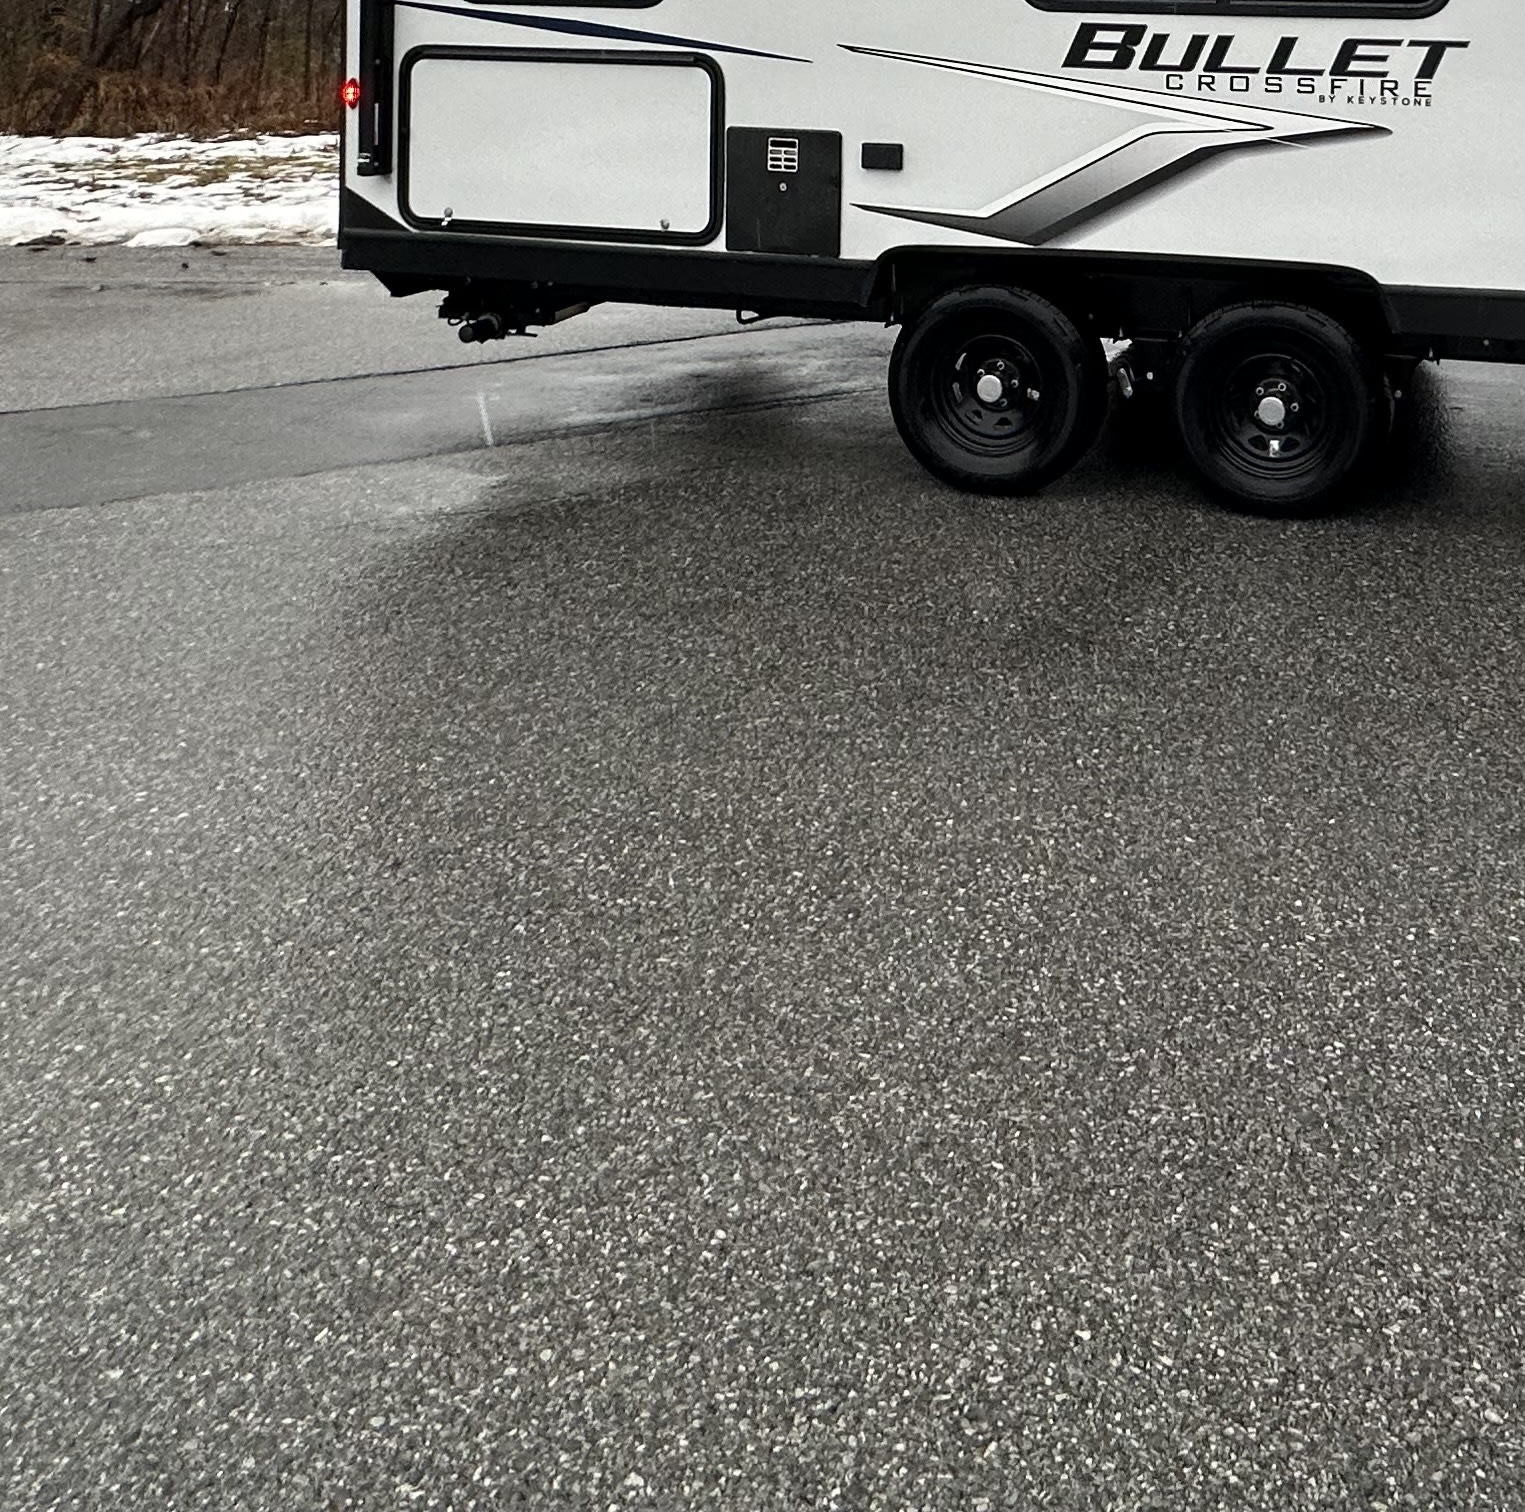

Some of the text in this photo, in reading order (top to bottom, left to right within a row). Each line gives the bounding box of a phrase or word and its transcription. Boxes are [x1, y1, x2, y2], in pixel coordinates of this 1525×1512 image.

[1061, 22, 1470, 80] BULLET
[1166, 74, 1432, 98] CROSSFIRE
[1318, 94, 1432, 107] BY KEYSTONE
